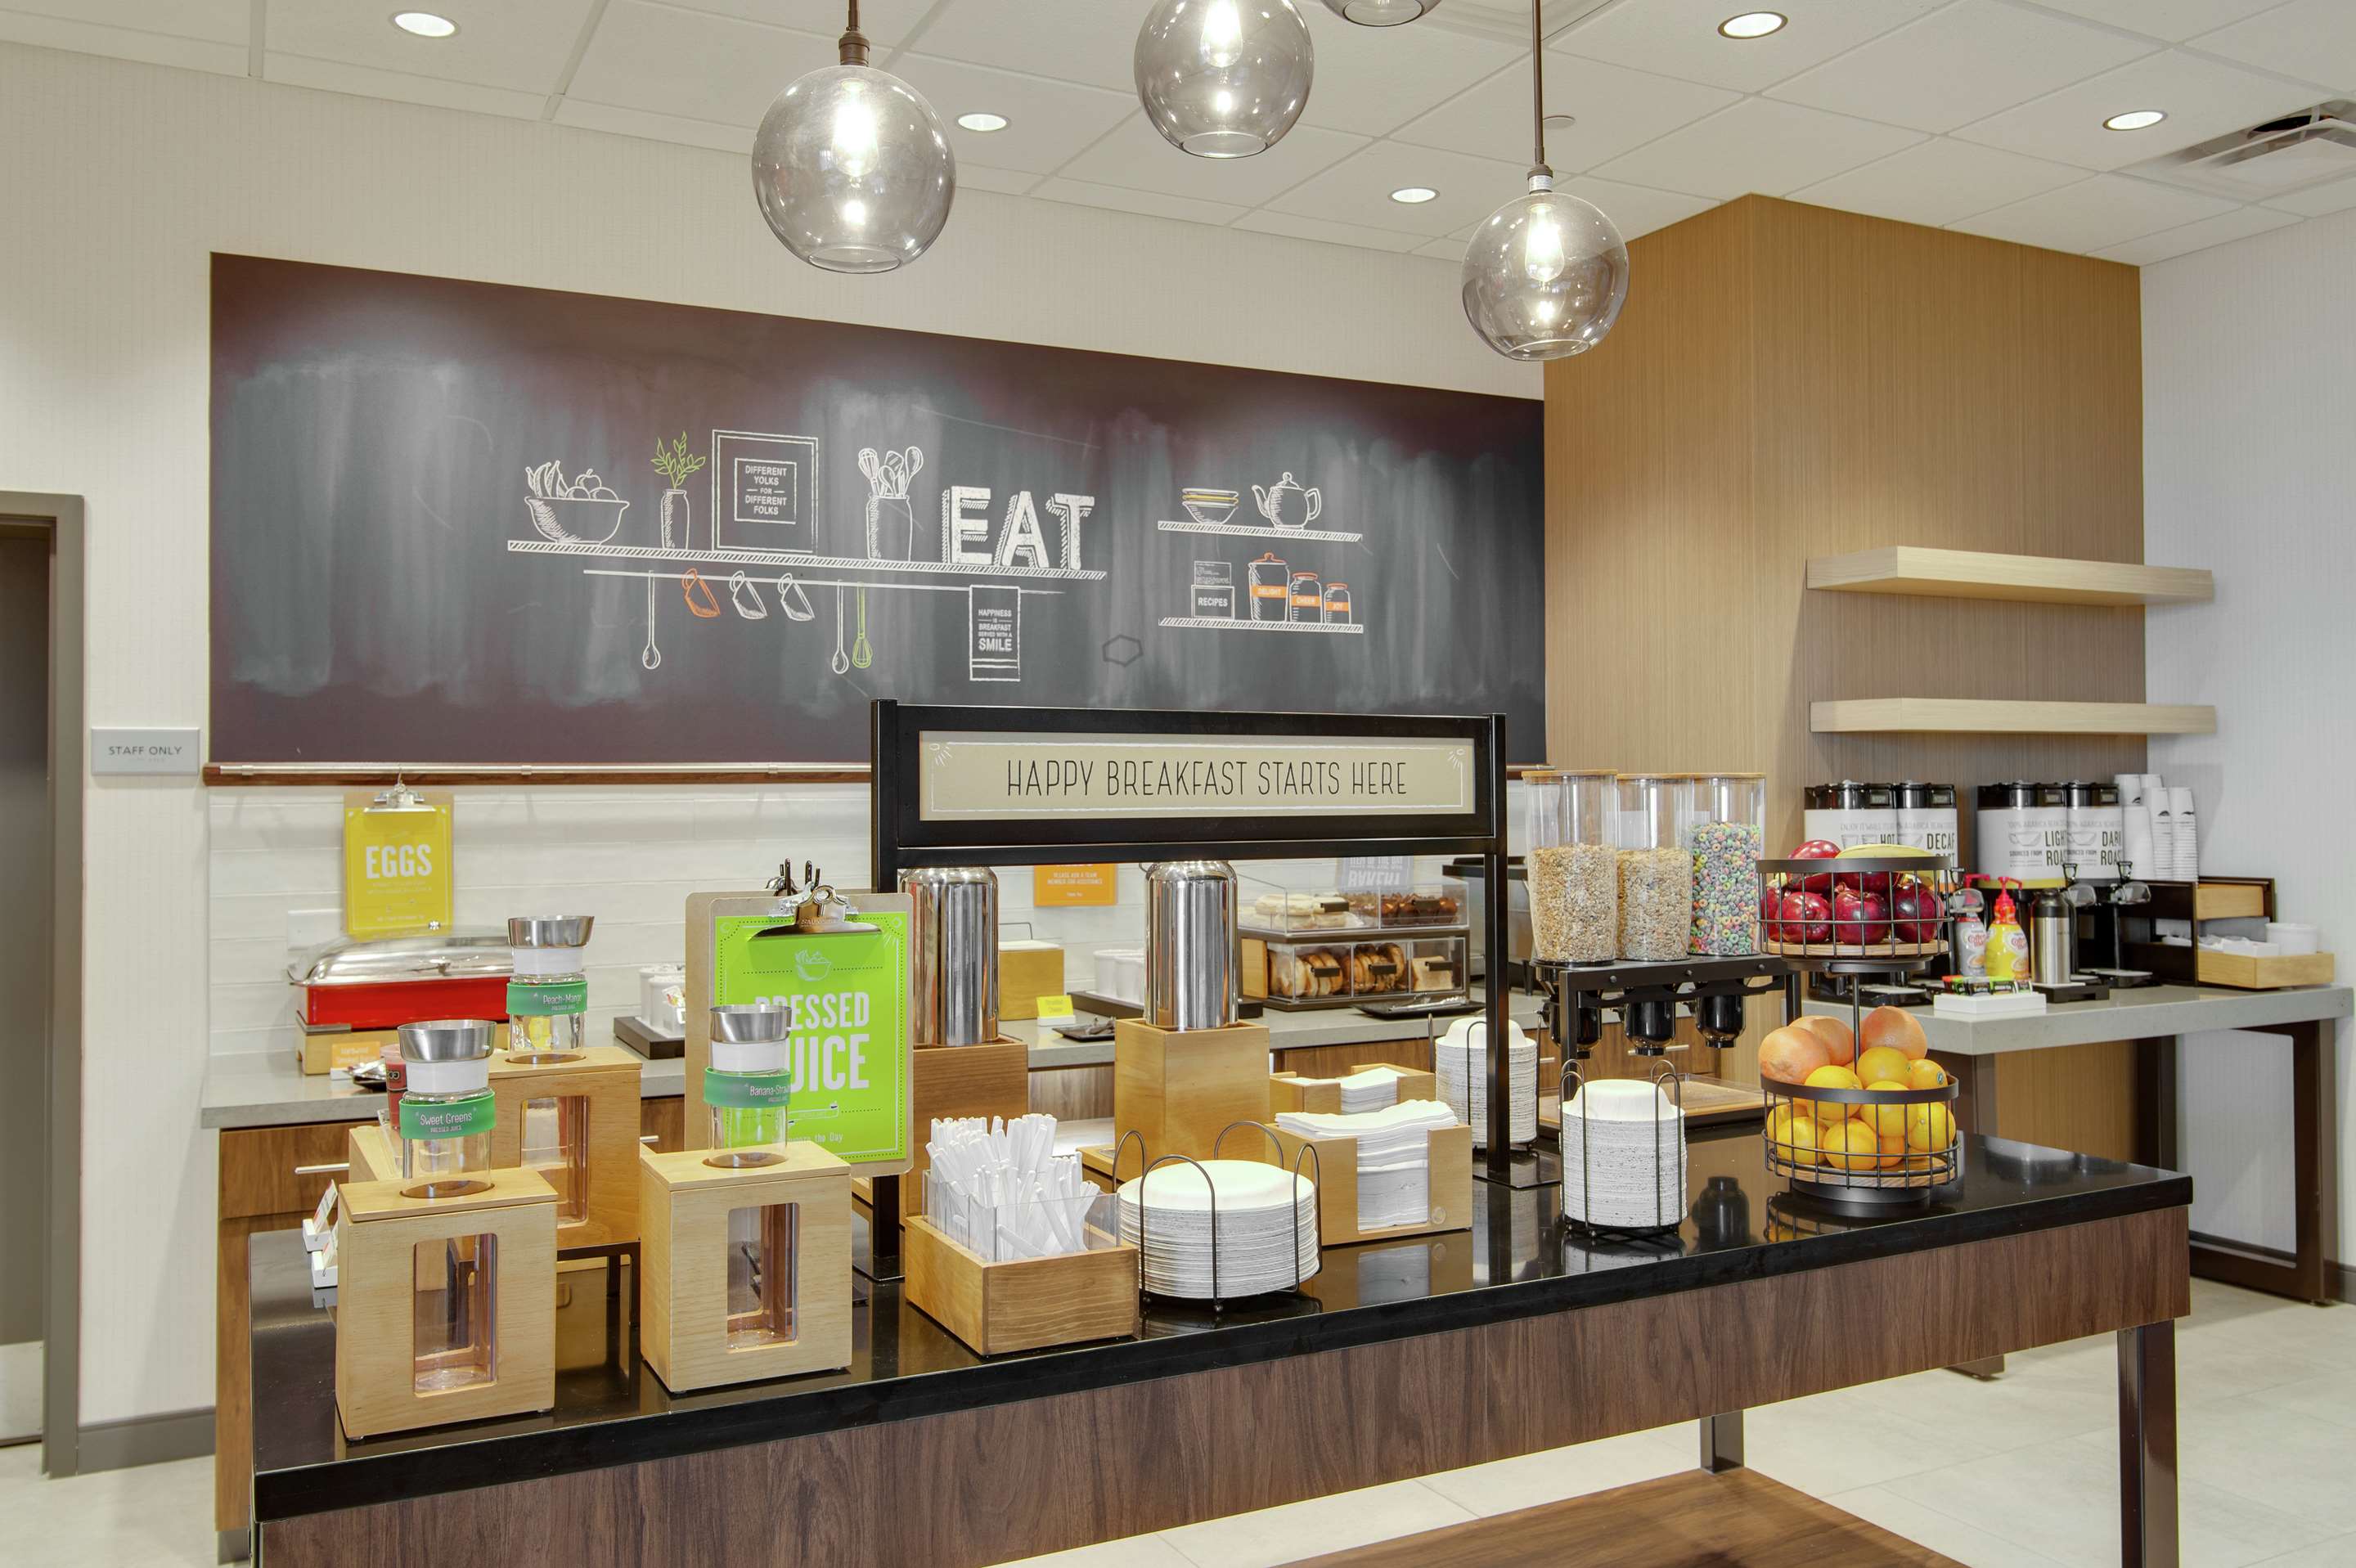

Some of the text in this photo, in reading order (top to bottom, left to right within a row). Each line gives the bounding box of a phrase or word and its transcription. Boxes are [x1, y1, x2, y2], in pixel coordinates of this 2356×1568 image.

[745, 465, 787, 476] DIFFERENT
[753, 476, 779, 486] YOLKS
[745, 495, 787, 505] DIFFERENT
[753, 505, 779, 515] FOLKS
[942, 486, 1095, 570] EAT
[1257, 588, 1281, 596] DELIGHT
[1198, 597, 1228, 607] RECIPES
[978, 609, 1012, 617] HAPPINESS
[978, 623, 1011, 631] BREAKFAST
[978, 638, 1013, 652] SMILE
[108, 745, 182, 756] STAFF ONLY
[1007, 759, 1407, 797] HAPPY BREAKFAST STARTS HERE
[1927, 833, 1955, 850] DECAF
[366, 843, 433, 879] EGGS
[2046, 850, 2066, 866] ROA
[2100, 850, 2121, 866] ROAS
[543, 994, 582, 1004] Peach-Mango
[755, 991, 870, 1031] ESSED
[785, 1033, 870, 1093] UICE
[420, 1112, 473, 1125] Sweet Greens
[830, 1132, 843, 1143] Day
